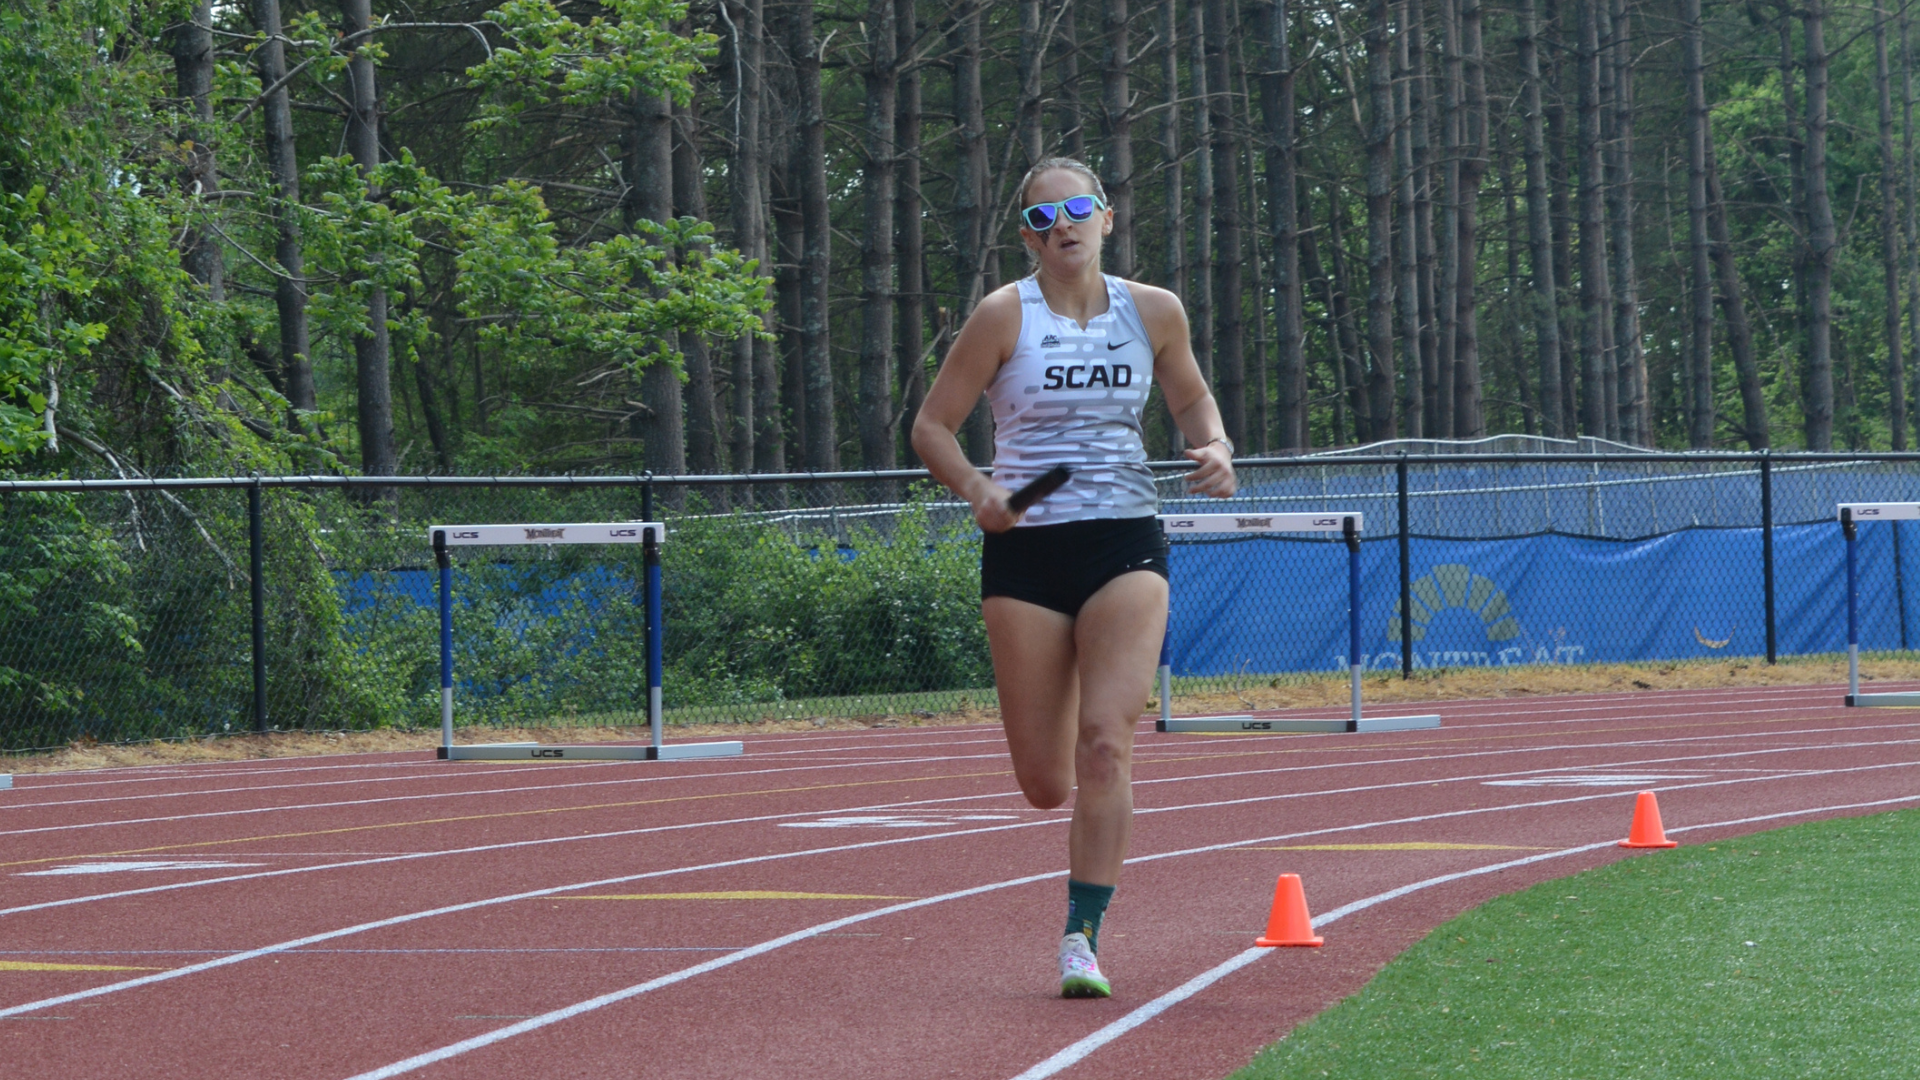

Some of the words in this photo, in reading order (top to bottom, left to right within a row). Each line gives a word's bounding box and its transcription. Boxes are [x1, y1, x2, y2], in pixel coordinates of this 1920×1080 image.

[1043, 364, 1132, 390] SCAD
[1857, 508, 1880, 516] UCS
[1170, 520, 1195, 528] UCS
[1312, 518, 1338, 526] UCS
[452, 531, 479, 539] UCS
[609, 529, 636, 537] UCS
[1242, 722, 1271, 730] UCS
[531, 749, 564, 758] UCS
